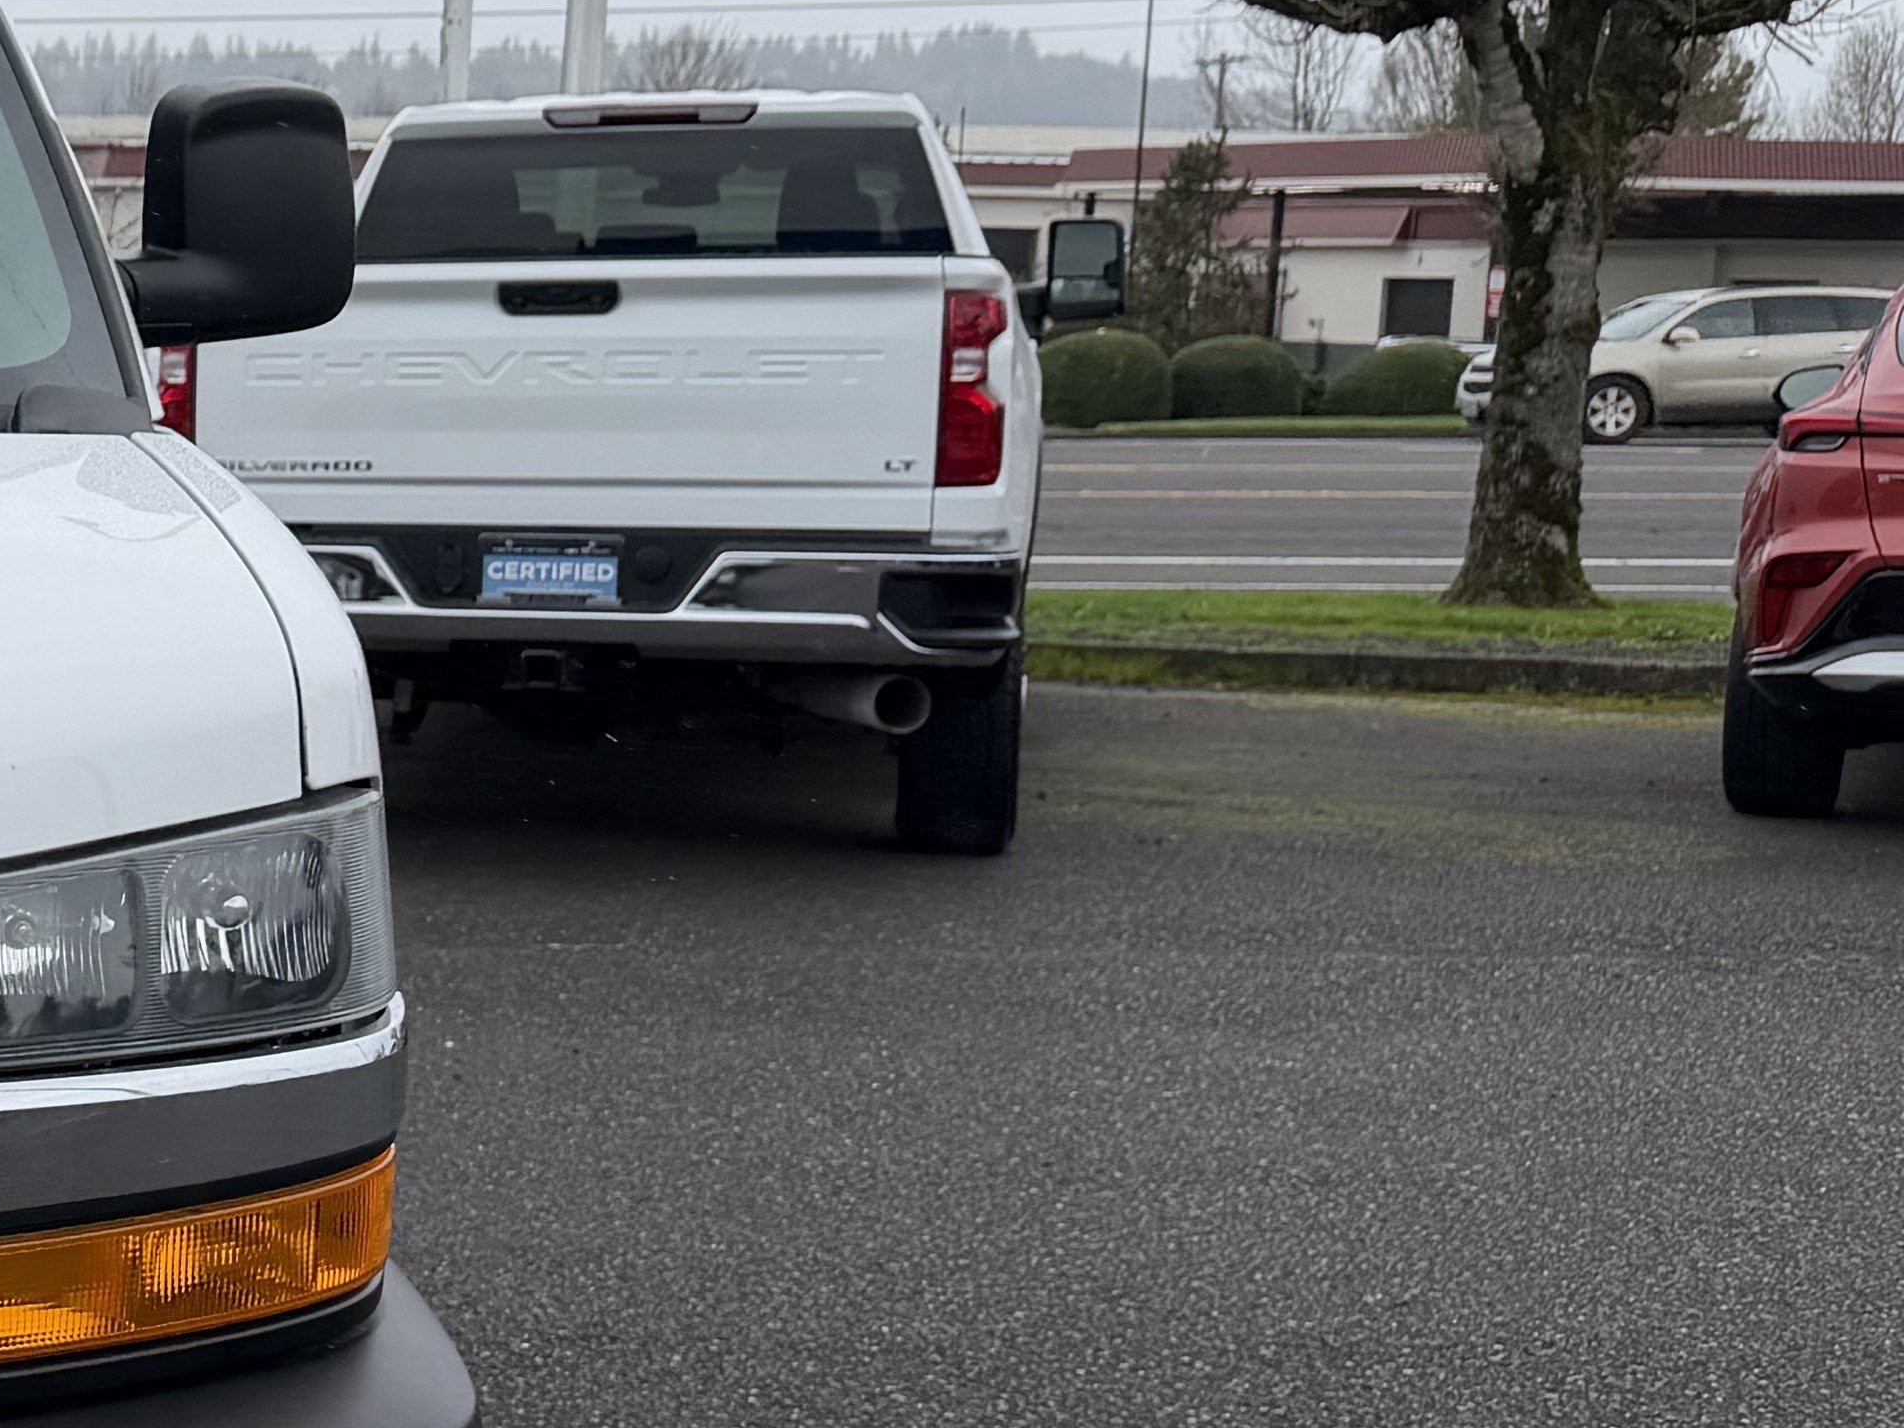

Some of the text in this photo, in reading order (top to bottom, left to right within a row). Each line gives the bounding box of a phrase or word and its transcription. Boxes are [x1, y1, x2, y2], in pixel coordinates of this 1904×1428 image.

[245, 350, 884, 386] CHEVROLET
[884, 459, 917, 472] LT
[487, 560, 614, 582] CERTIFIED
